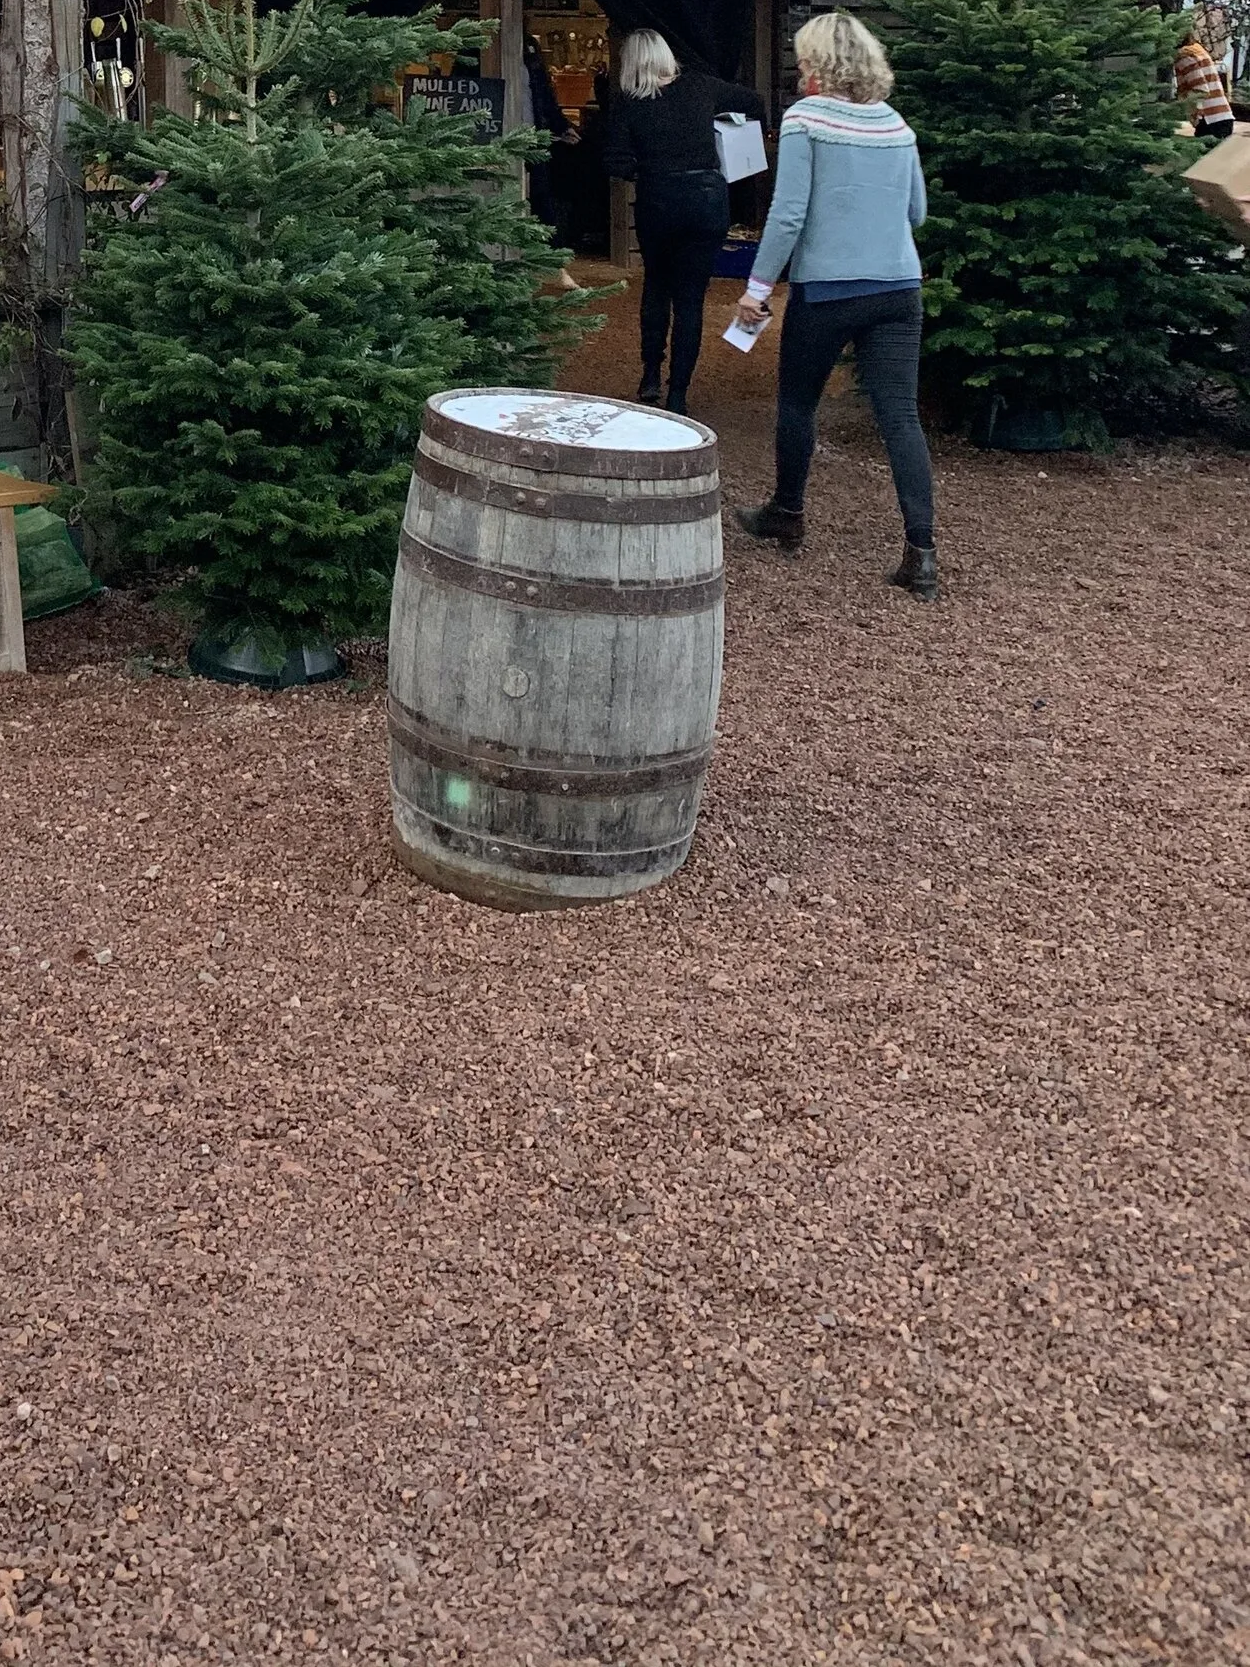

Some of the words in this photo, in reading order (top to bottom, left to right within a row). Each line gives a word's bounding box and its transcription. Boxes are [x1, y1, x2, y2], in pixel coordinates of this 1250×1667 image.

[412, 77, 480, 95] MULLED
[425, 95, 455, 113] INE
[459, 97, 493, 114] AND
